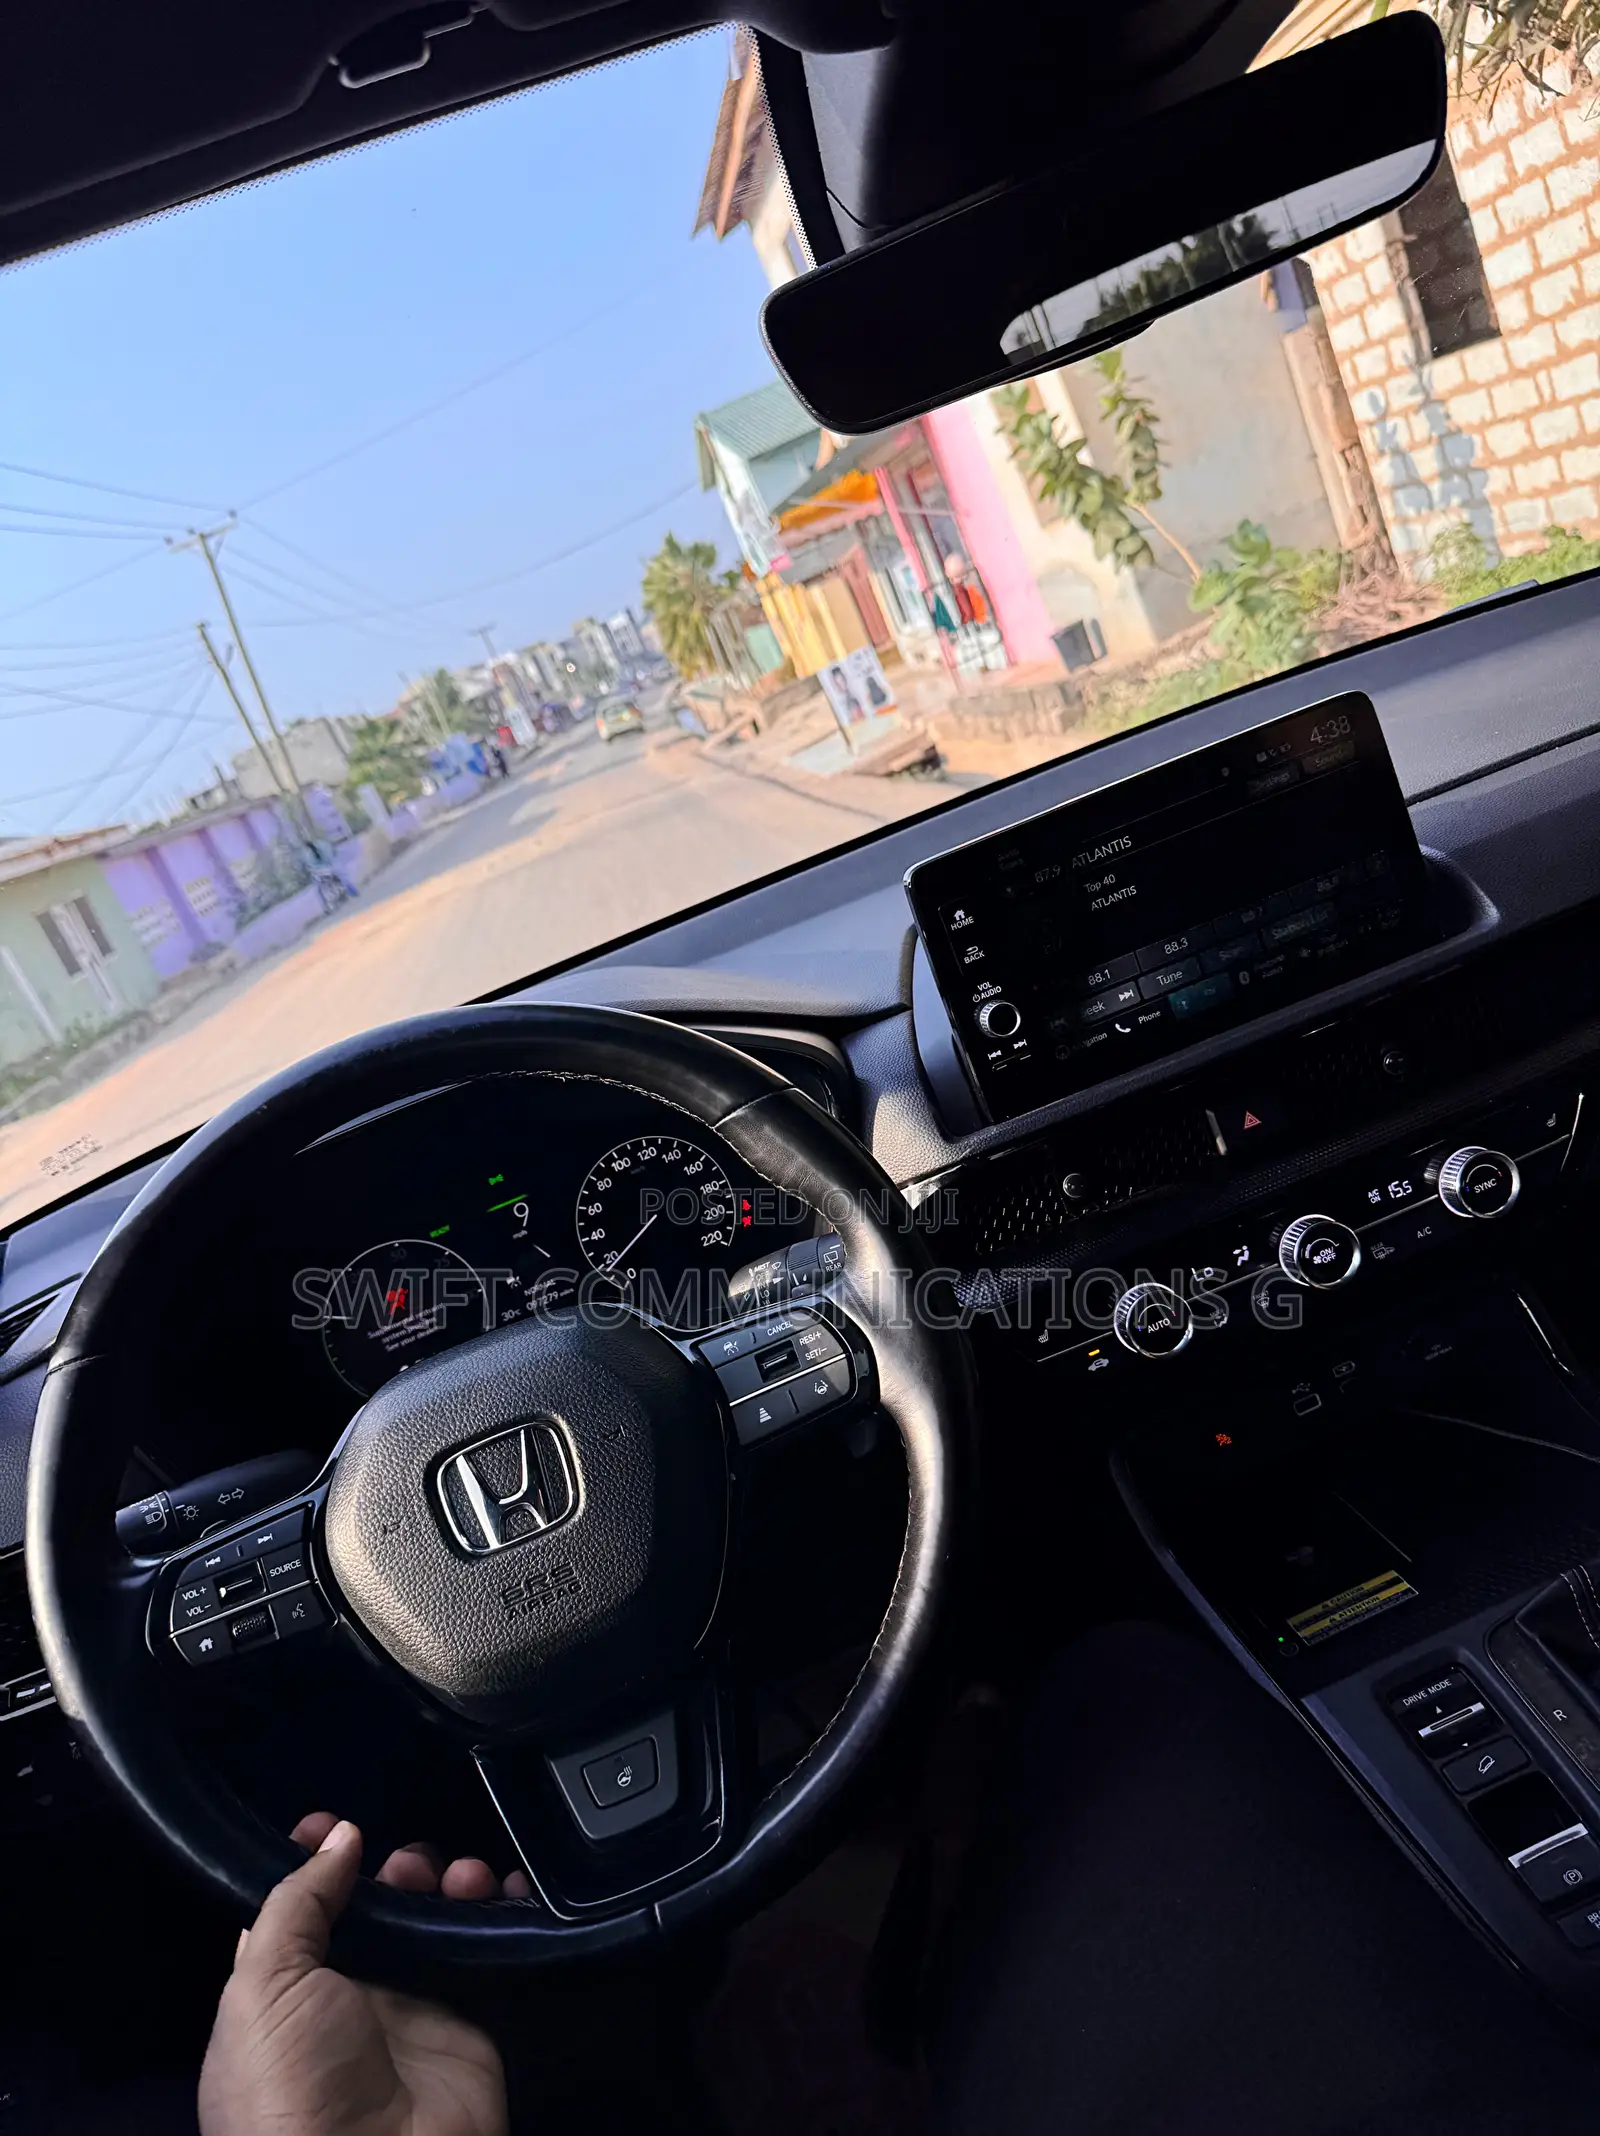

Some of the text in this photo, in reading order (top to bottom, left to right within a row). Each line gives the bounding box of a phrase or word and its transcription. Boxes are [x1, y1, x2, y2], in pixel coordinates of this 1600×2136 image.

[1310, 715, 1351, 743] 4:38
[1034, 835, 1133, 883] 87.9 ATLANTIS
[1083, 873, 1117, 894] Top 40
[1091, 884, 1138, 912] ATLANTIS
[950, 915, 975, 931] HOME
[1164, 936, 1189, 955] 88.3
[963, 950, 986, 965] BACK
[1087, 968, 1112, 987] 88.1
[1156, 968, 1184, 987] Tune
[976, 980, 993, 992] VOL
[980, 985, 1003, 1000] AUDIO
[1080, 1000, 1107, 1018] eek
[1137, 1009, 1162, 1026] Phone
[636, 1146, 657, 1163] 120
[661, 1148, 682, 1164] 140
[610, 1156, 631, 1173] 100
[682, 1160, 704, 1176] 160
[596, 1177, 613, 1192] 80
[699, 1180, 720, 1196] 180
[1387, 1179, 1414, 1199] 15.5
[1473, 1178, 1498, 1194] SYNC
[512, 1201, 529, 1227] 9
[587, 1201, 603, 1216] 60
[703, 1204, 725, 1221] 200
[590, 1227, 606, 1242] 40
[700, 1229, 723, 1248] 220
[1416, 1226, 1433, 1239] A/C
[603, 1250, 620, 1265] 20
[1319, 1245, 1336, 1258] ON/
[1322, 1252, 1338, 1265] OFF
[626, 1267, 637, 1280] 0
[825, 1262, 843, 1273] REAR
[760, 1289, 771, 1299] LO
[766, 1320, 794, 1337] CANCEL
[1146, 1317, 1172, 1334] AUTO
[798, 1330, 823, 1346] RES/+
[269, 1560, 302, 1577] SOURCE
[1402, 1678, 1453, 1707] DRIVE MODE
[1552, 1708, 1568, 1722] R
